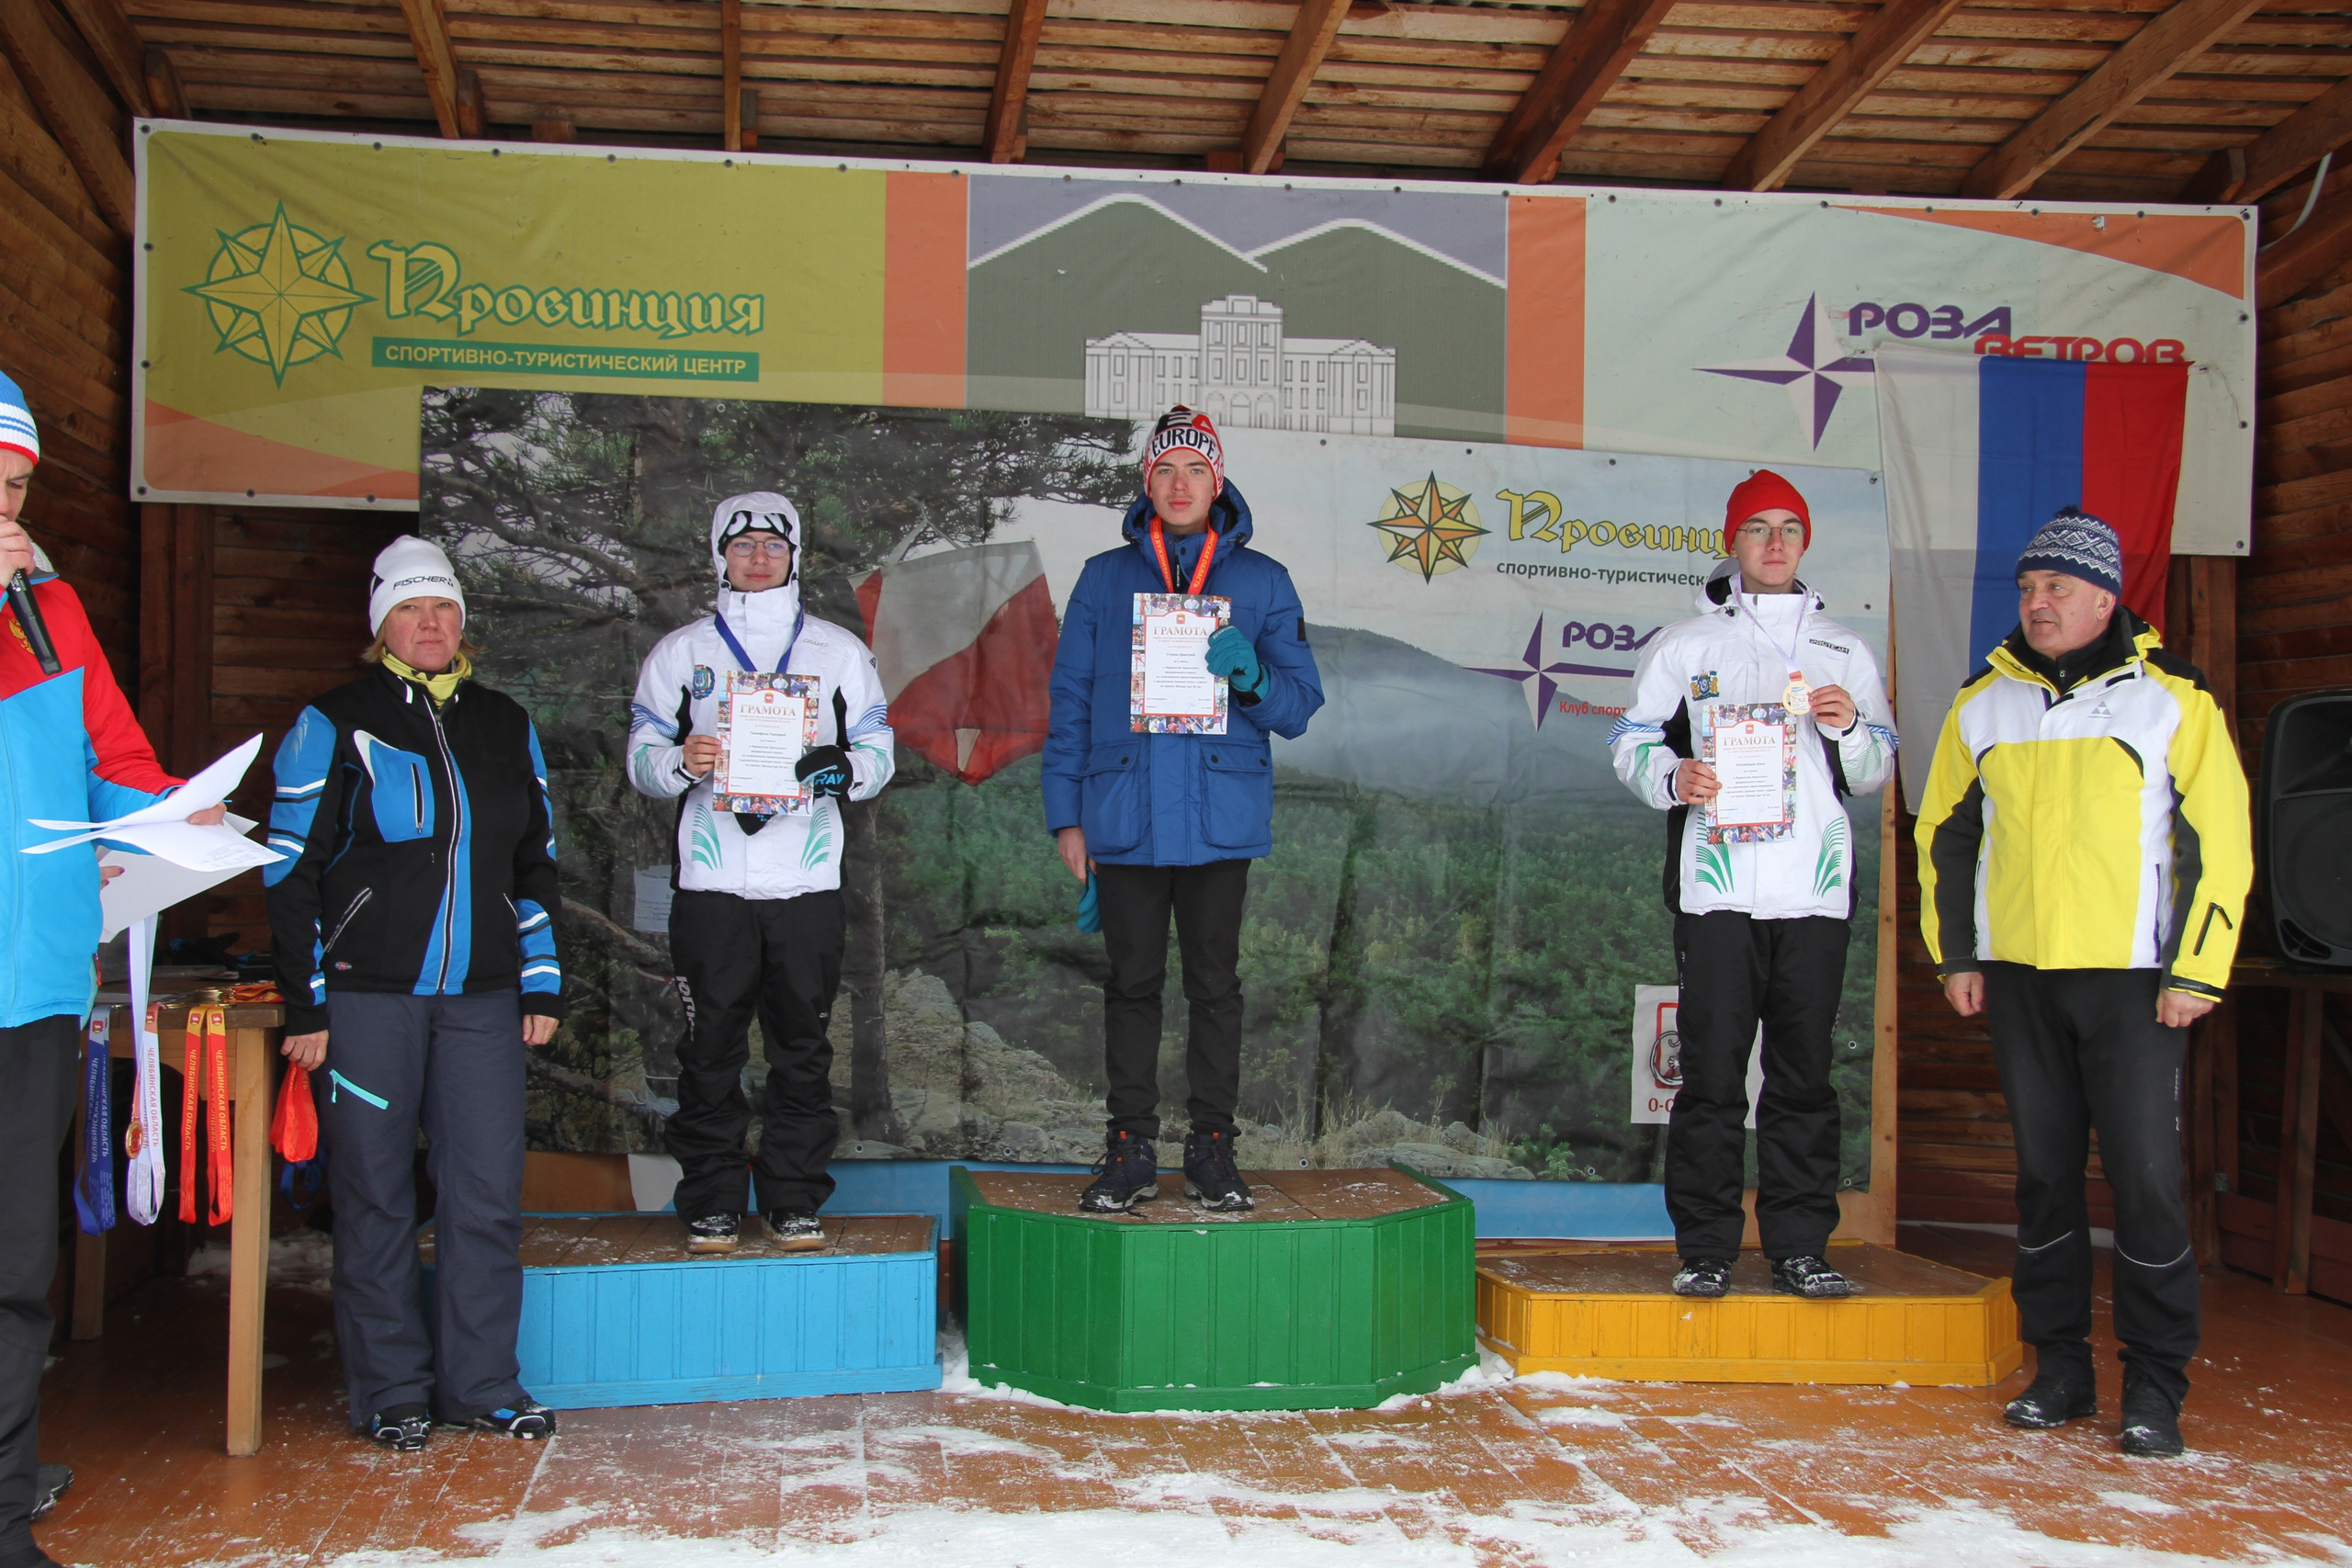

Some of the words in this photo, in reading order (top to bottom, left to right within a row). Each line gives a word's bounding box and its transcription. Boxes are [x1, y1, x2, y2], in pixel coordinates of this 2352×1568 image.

[367, 240, 764, 340] Провинция
[1849, 302, 2011, 339] РОЗА
[385, 344, 679, 373] СПОРТИВНО-ТУРИСТИЧЕСКИЙ
[684, 356, 746, 375] ЦЕНТР
[1152, 428, 1216, 459] EUROPE
[1496, 489, 1731, 559] Провинц
[392, 575, 447, 591] FISCHER
[1497, 562, 1708, 586] спортивно-туристическ
[1153, 626, 1207, 636] ГРАМОТА
[740, 705, 797, 716] ГРАМОТА
[1559, 701, 1589, 717] Клуб
[1591, 705, 1628, 719] спорт
[1723, 736, 1776, 747] ГРАМОТА
[148, 1047, 157, 1108] ЧЕЛЯБИНСКАЯ
[187, 1049, 197, 1111] ЧЕЛЯБИНСКАЯ
[215, 1049, 225, 1111] ЧЕЛЯБИНСКАЯ
[101, 1118, 109, 1157] ОБЛАСТЬ
[151, 1109, 159, 1147] ОБЛАСТЬ
[185, 1111, 193, 1151] ОБЛАСТЬ
[219, 1111, 227, 1151] ОБЛАСТЬ
